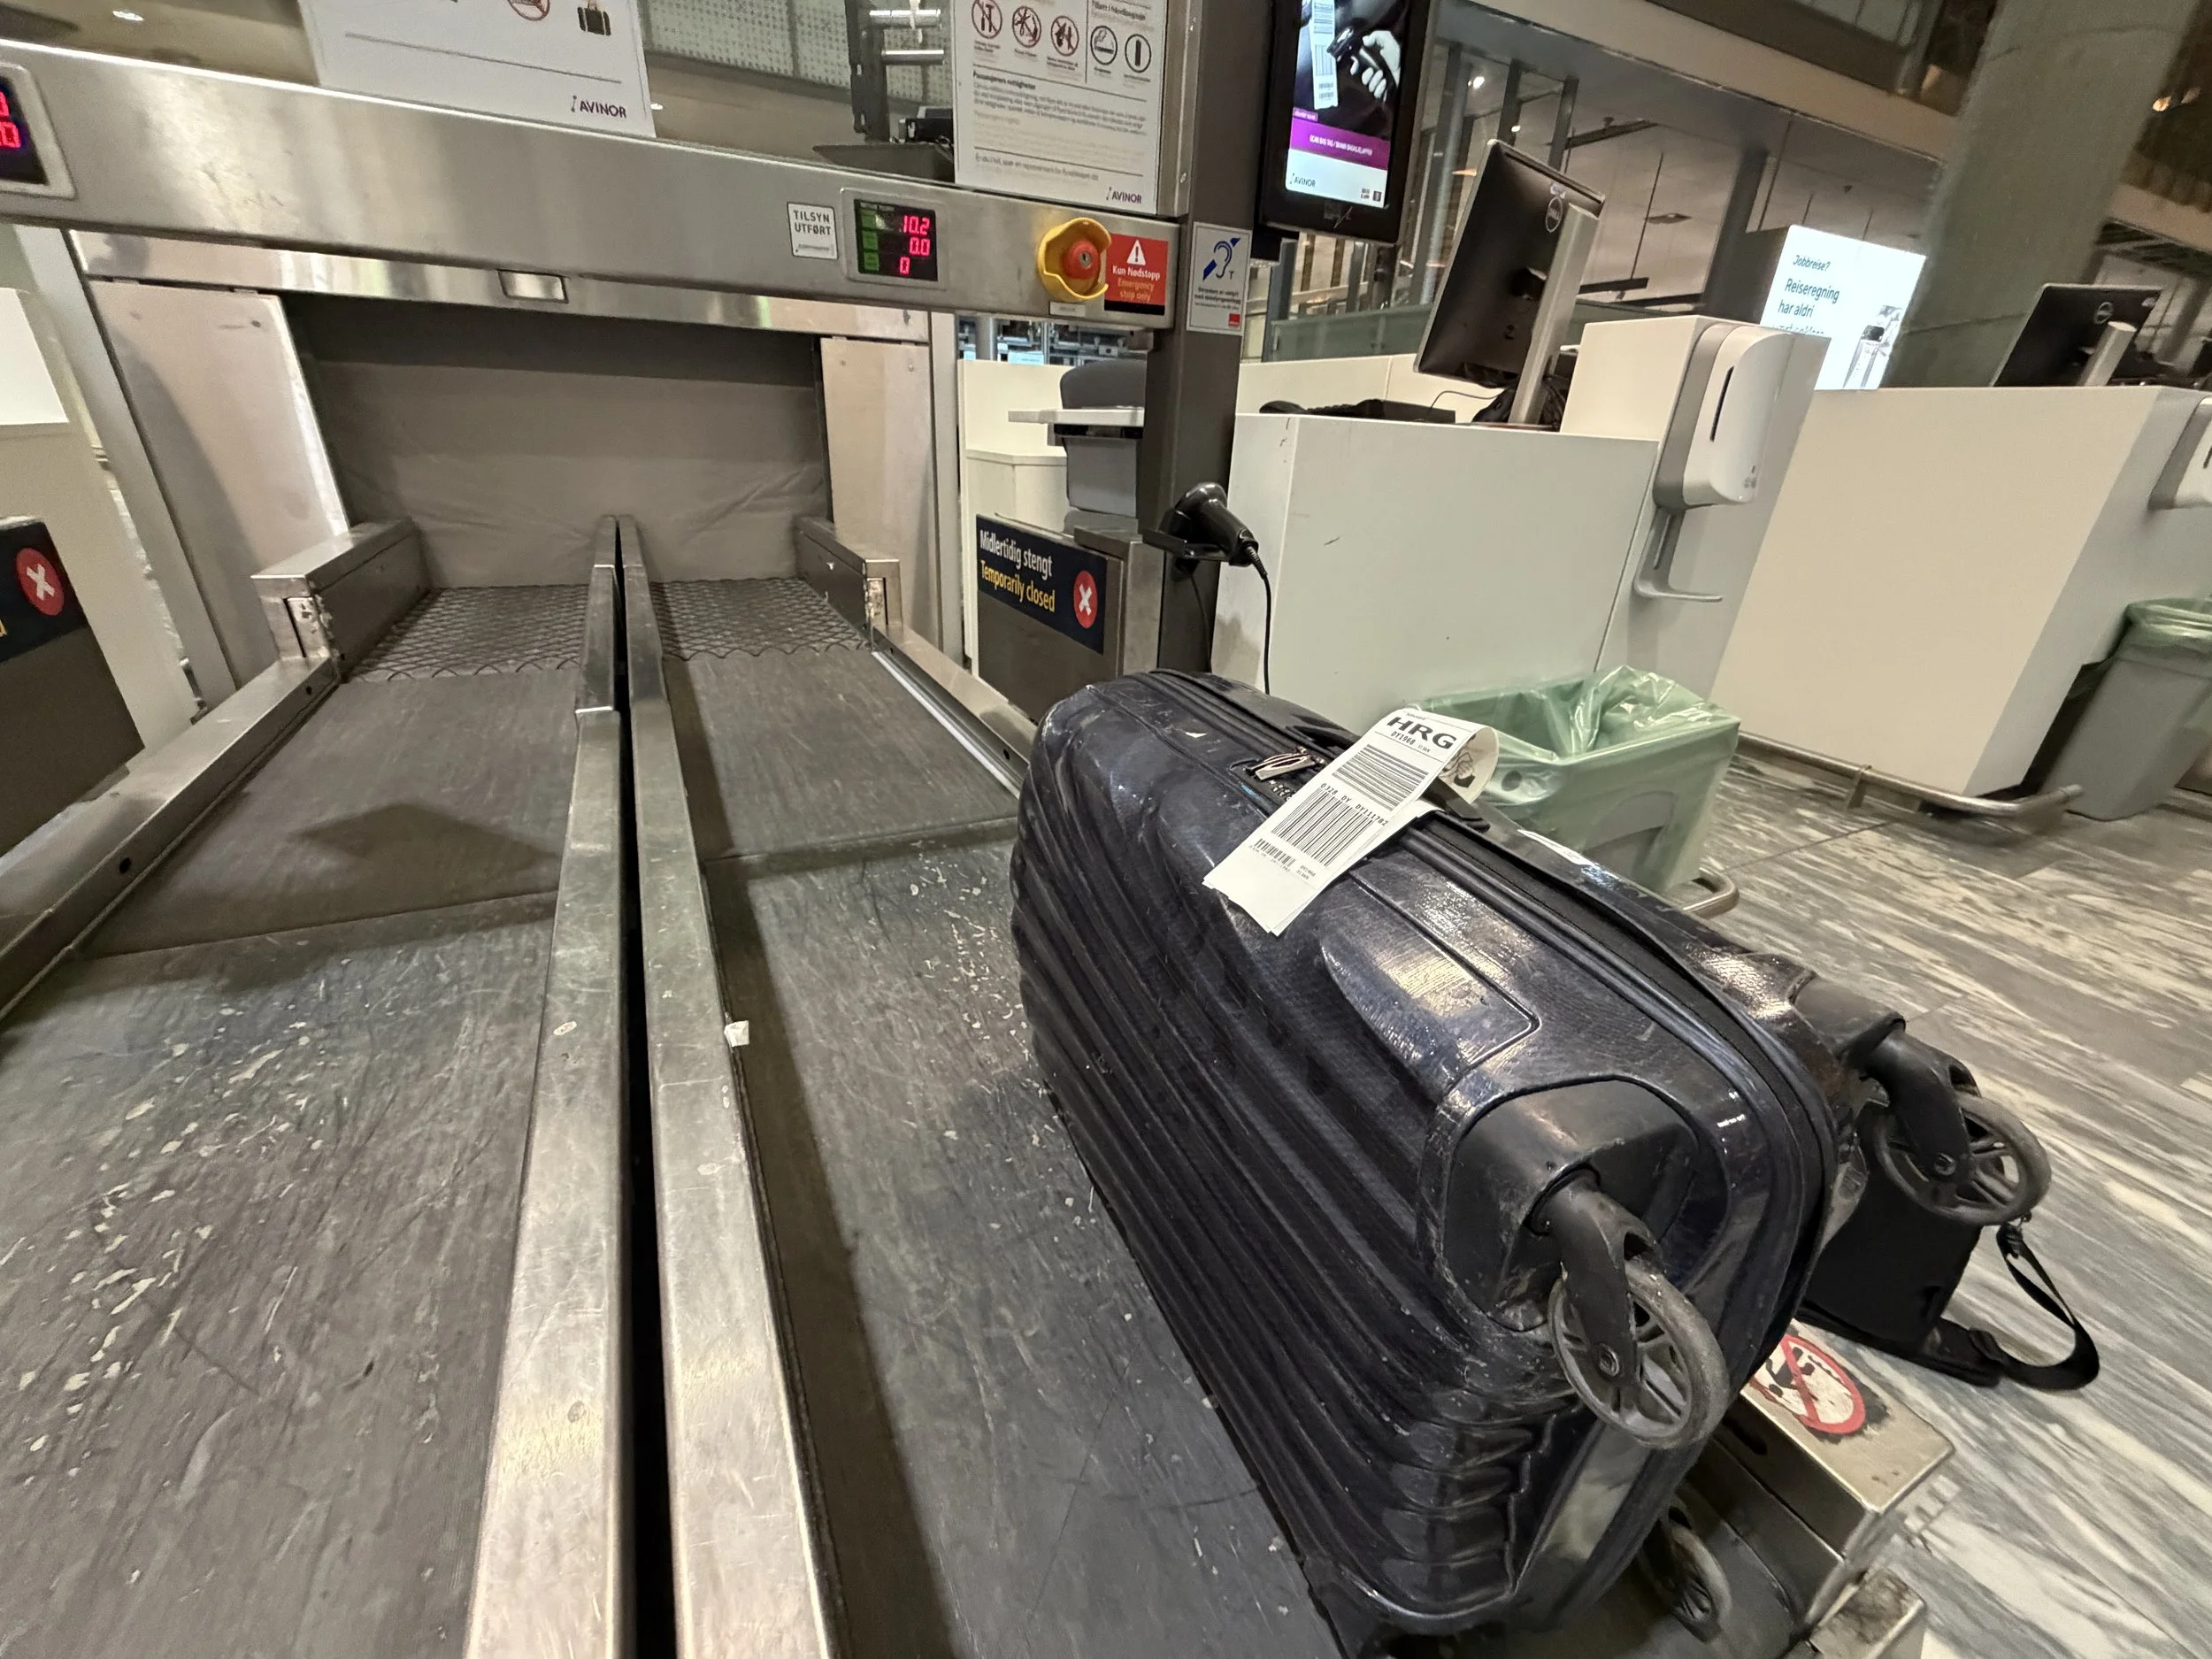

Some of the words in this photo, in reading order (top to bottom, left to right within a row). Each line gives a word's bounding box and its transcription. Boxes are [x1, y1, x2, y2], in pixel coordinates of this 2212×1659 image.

[579, 100, 627, 119] AVINOR
[1294, 176, 1317, 188] AVINOR
[1111, 190, 1142, 204] AVINOR
[793, 210, 830, 223] TILSYN
[902, 215, 931, 236] 10.2
[794, 223, 832, 236] UTFØRT
[899, 256, 910, 275] 0
[1793, 254, 1831, 272] Jobbreise?
[1112, 265, 1126, 275] Kun
[1127, 266, 1161, 281] Nødstopp
[1118, 277, 1155, 293] Emergency
[1785, 278, 1840, 304] Reiseregning
[1119, 291, 1135, 302] stop
[1136, 292, 1151, 303] only
[1778, 299, 1795, 314] har
[1793, 303, 1815, 318] aldri
[979, 529, 1022, 570] Midlertidig
[1023, 548, 1053, 580] stengt
[980, 559, 1025, 603] Temporarily
[1026, 580, 1056, 613] closed
[1386, 716, 1457, 749] HRG
